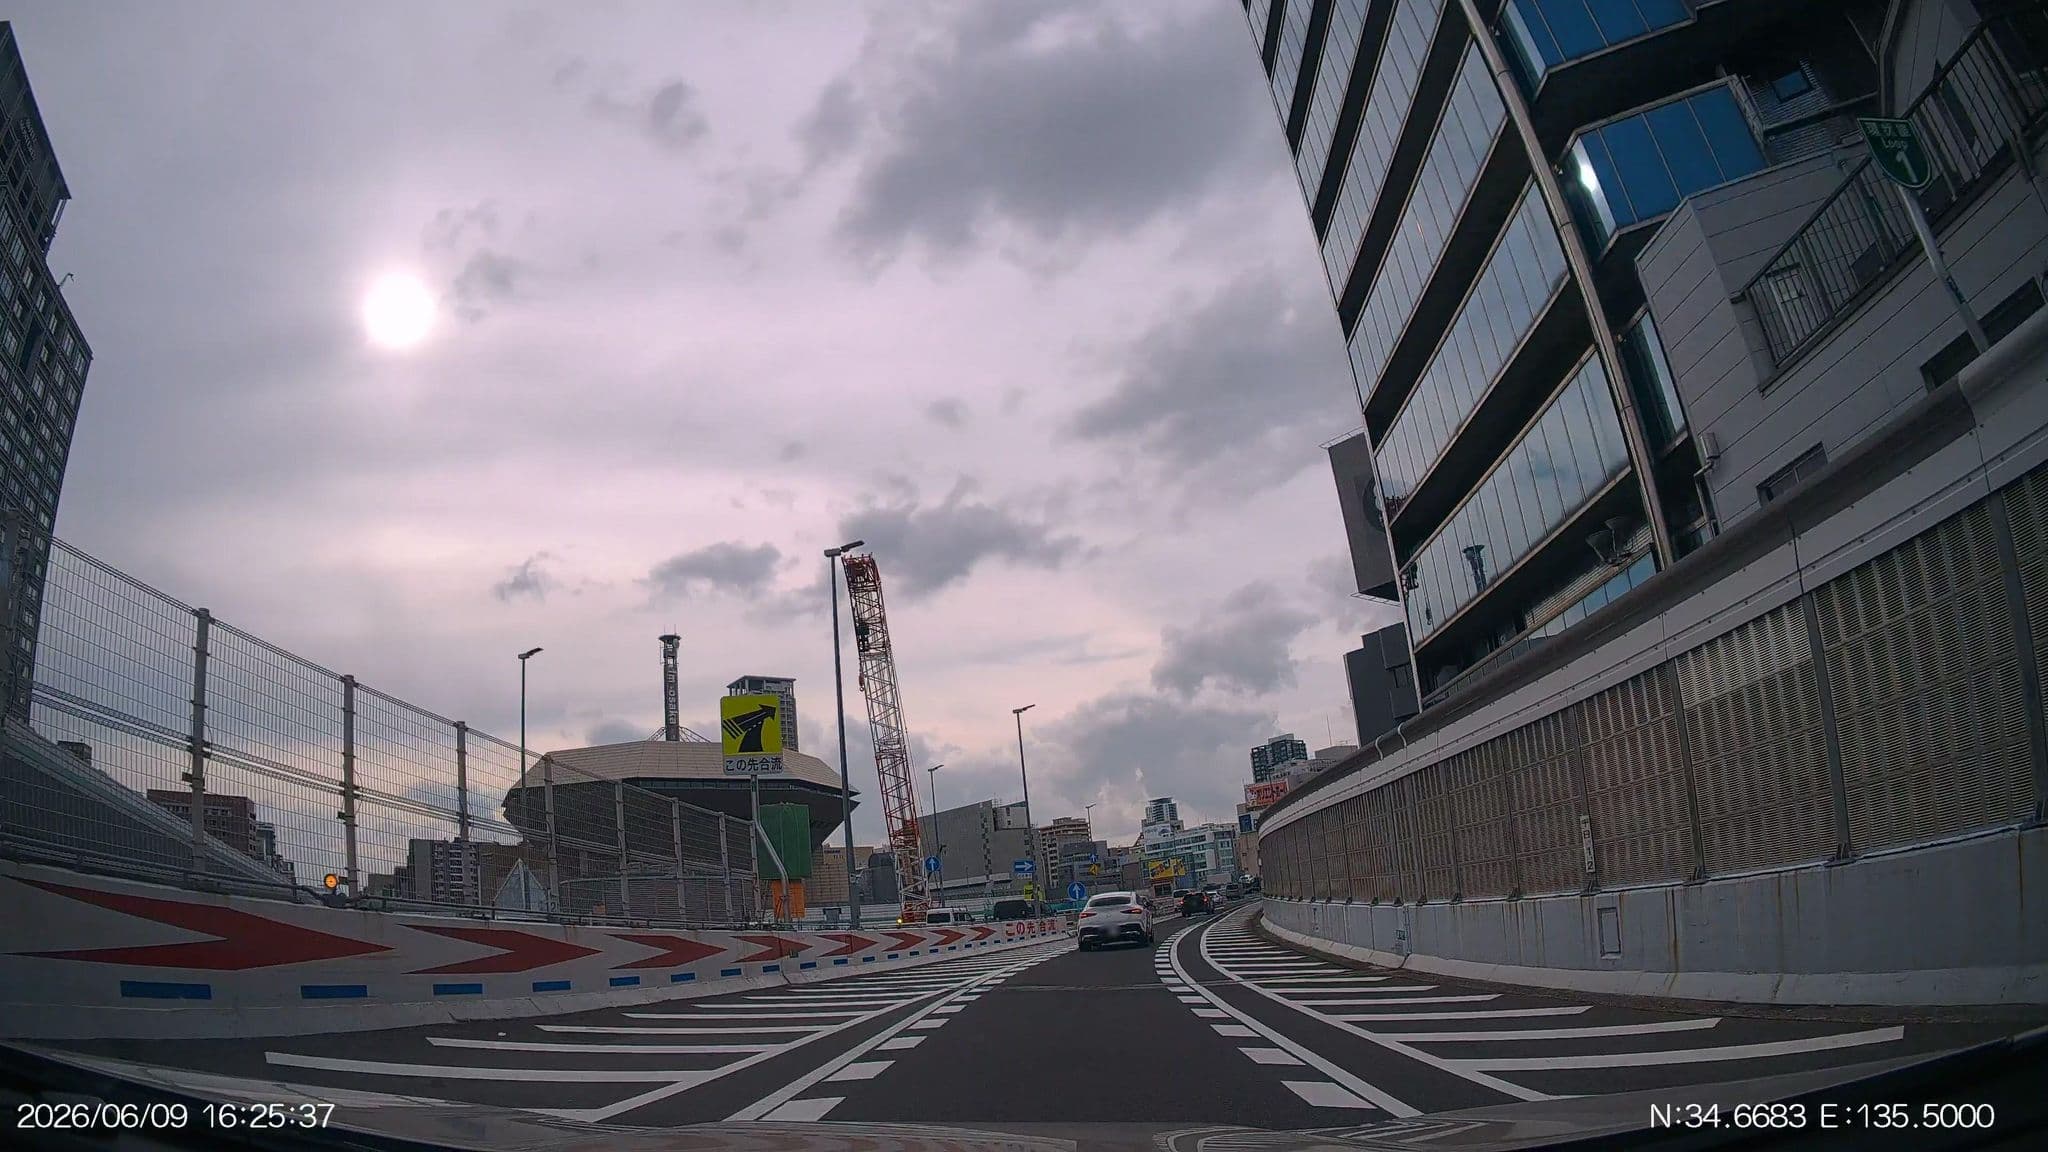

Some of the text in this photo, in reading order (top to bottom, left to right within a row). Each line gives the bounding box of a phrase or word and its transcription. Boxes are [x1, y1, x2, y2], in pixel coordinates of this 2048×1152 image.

[1896, 151, 1918, 183] 1
[725, 757, 783, 771] この先合流
[1006, 919, 1056, 936] この先合流
